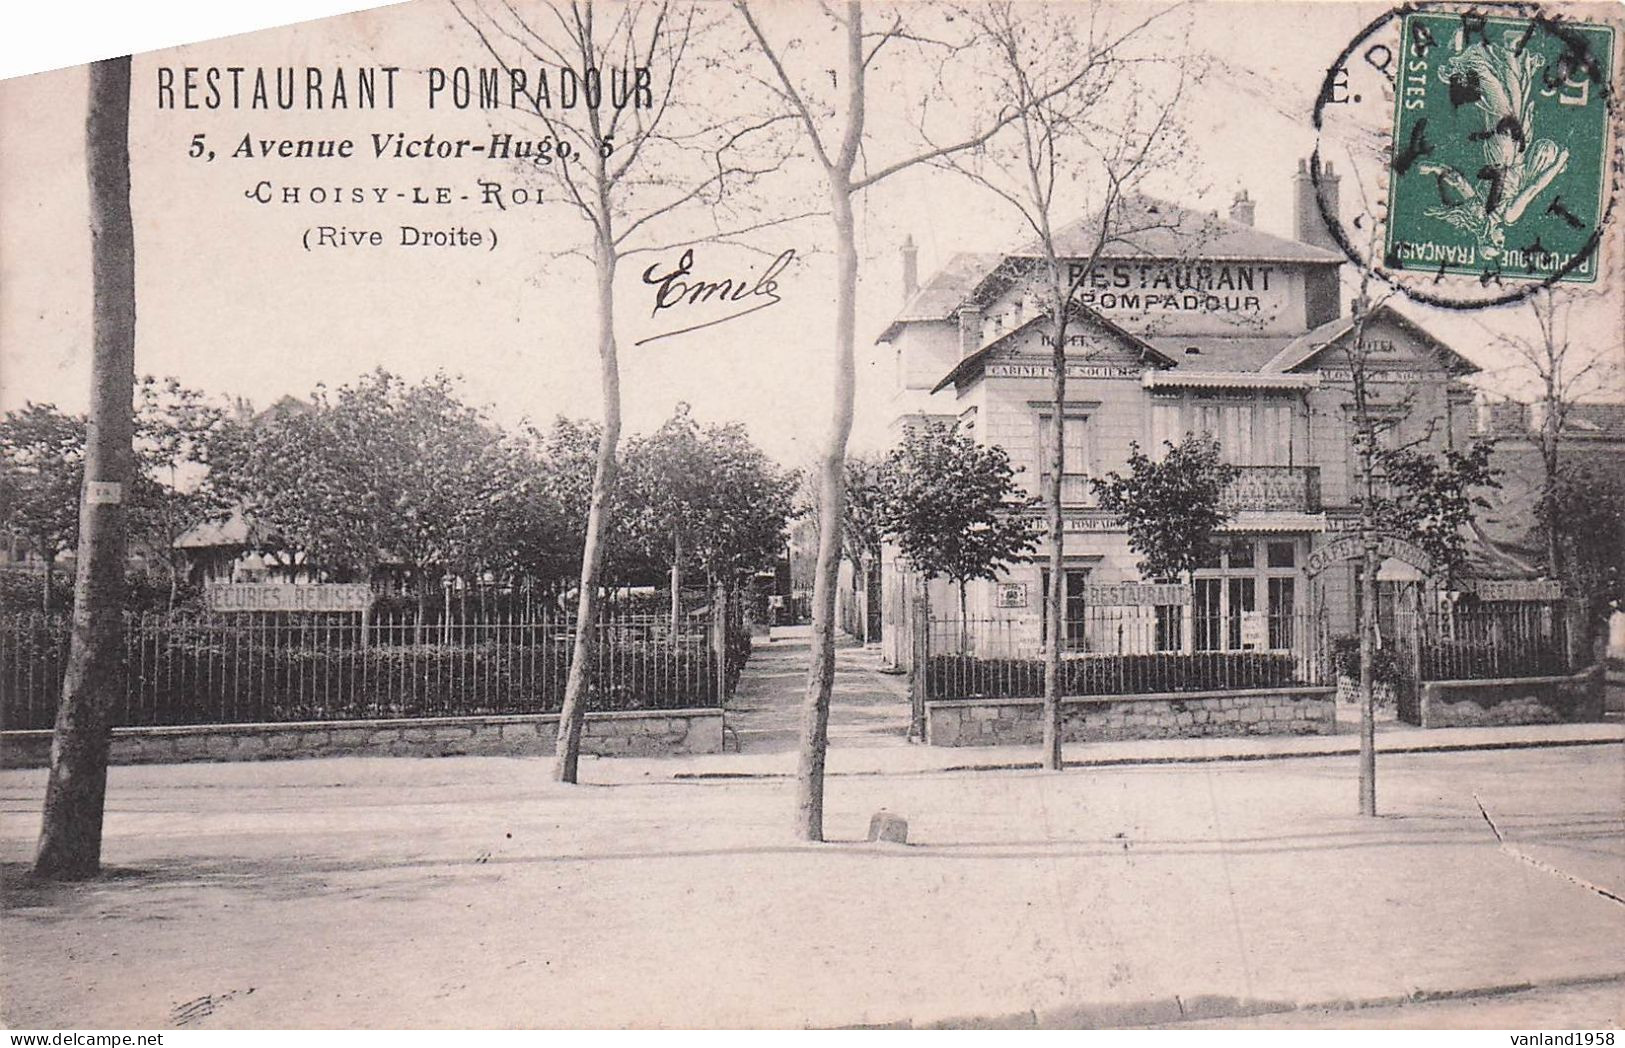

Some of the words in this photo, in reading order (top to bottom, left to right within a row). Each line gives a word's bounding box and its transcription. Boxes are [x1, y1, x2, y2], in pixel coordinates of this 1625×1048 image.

[642, 248, 796, 320] Emile
[1068, 263, 1274, 291] RESTAURANT
[1080, 292, 1262, 311] POMPADOUR
[1071, 519, 1126, 530] POMPADO
